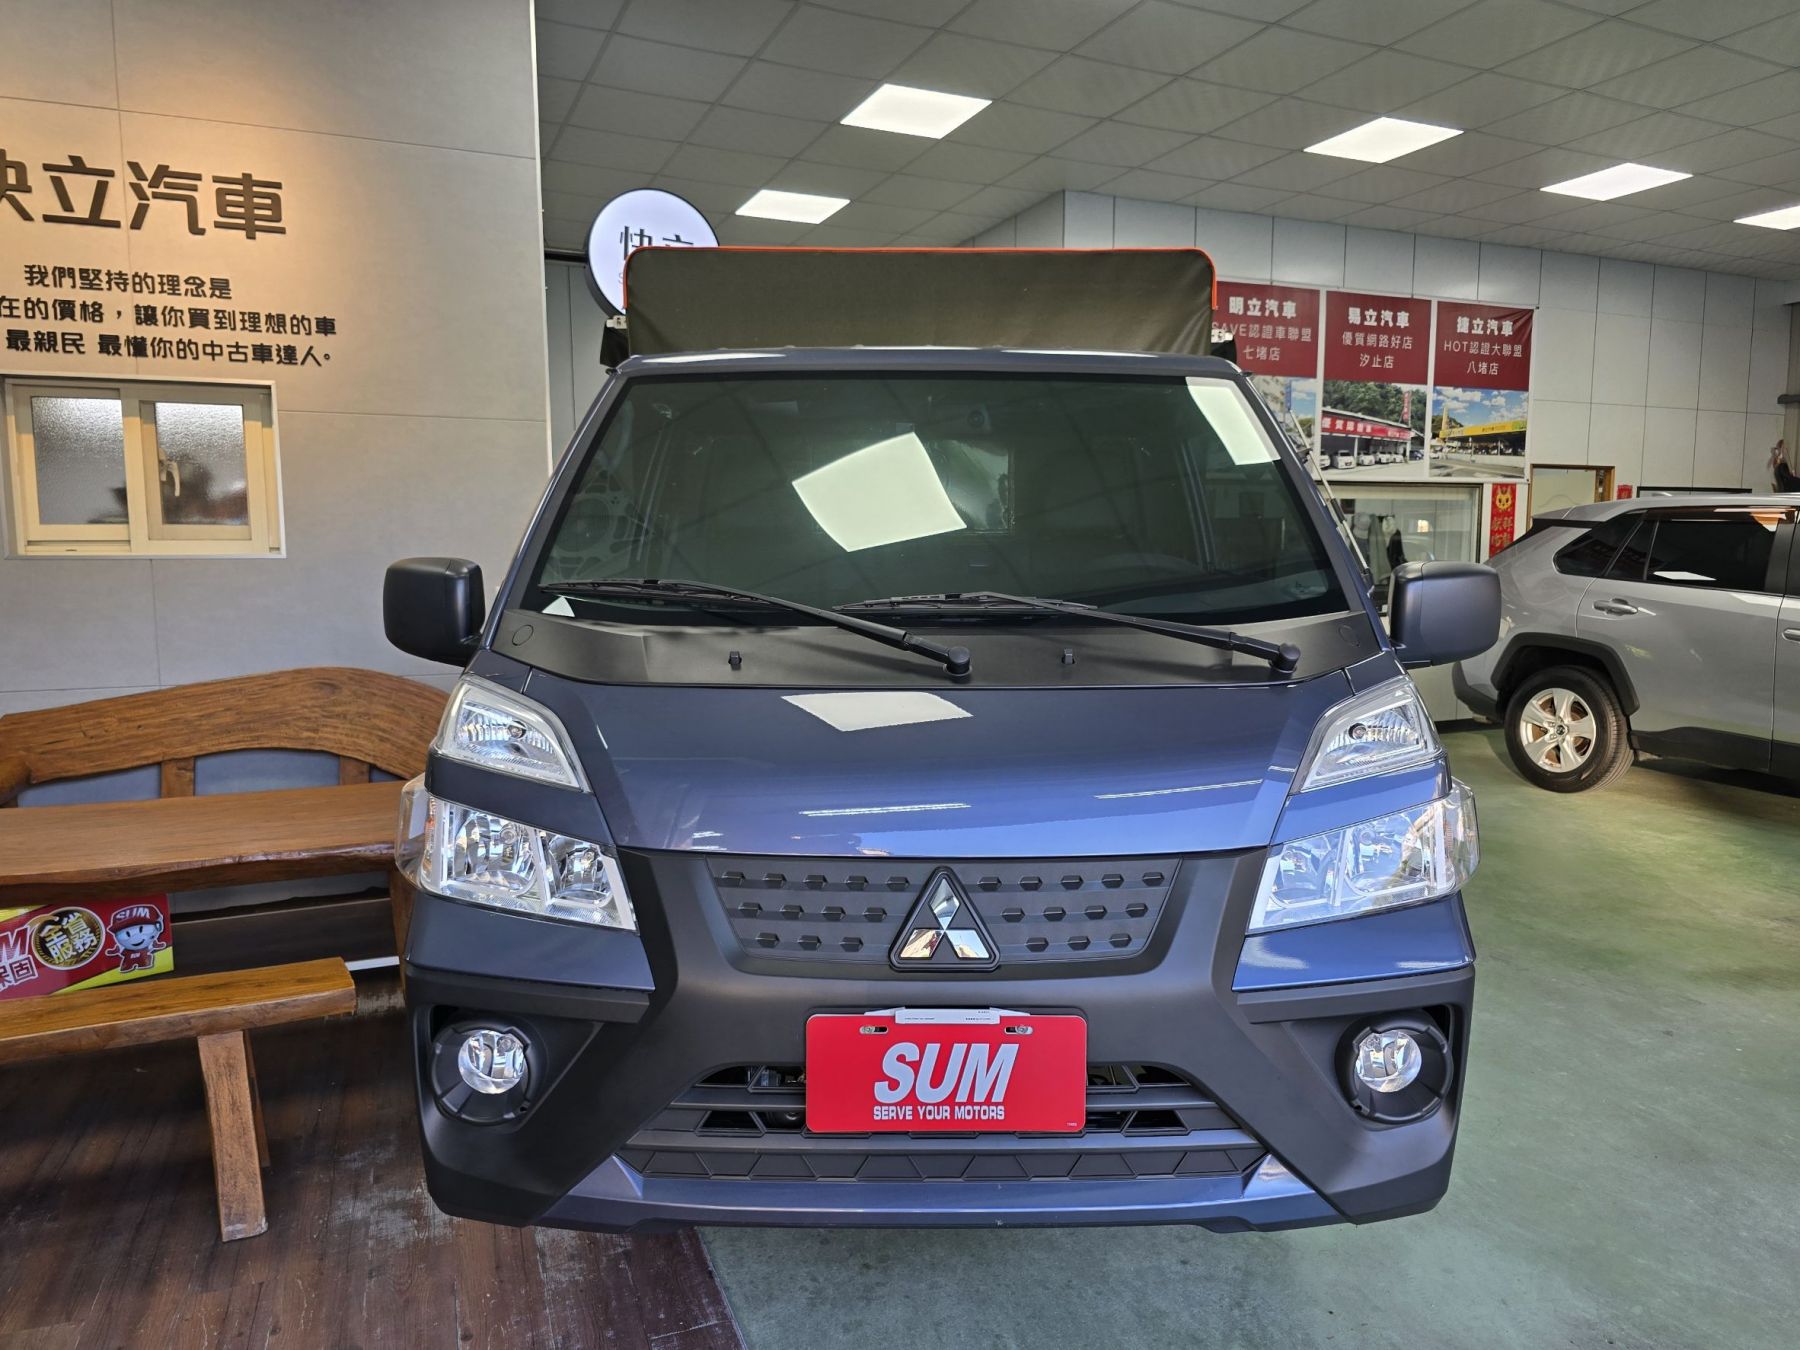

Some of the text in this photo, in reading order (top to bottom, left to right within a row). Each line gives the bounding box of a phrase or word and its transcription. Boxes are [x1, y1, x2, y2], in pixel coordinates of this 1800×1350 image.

[24, 264, 232, 299] 我們堅持的理念是
[1229, 296, 1297, 319] 明立汽車
[6, 329, 332, 367] 最親民 最懂你的中古車達人。
[1342, 331, 1413, 350] 優質網路好店
[1443, 340, 1522, 358] HOT認證大聯盟
[1243, 345, 1281, 361] 七堵店
[1359, 353, 1395, 369] 汐止店
[1466, 361, 1499, 375] 八堵店
[873, 1041, 1020, 1104] SUM
[873, 1105, 1005, 1121] SERVE YOUR MOTORS
